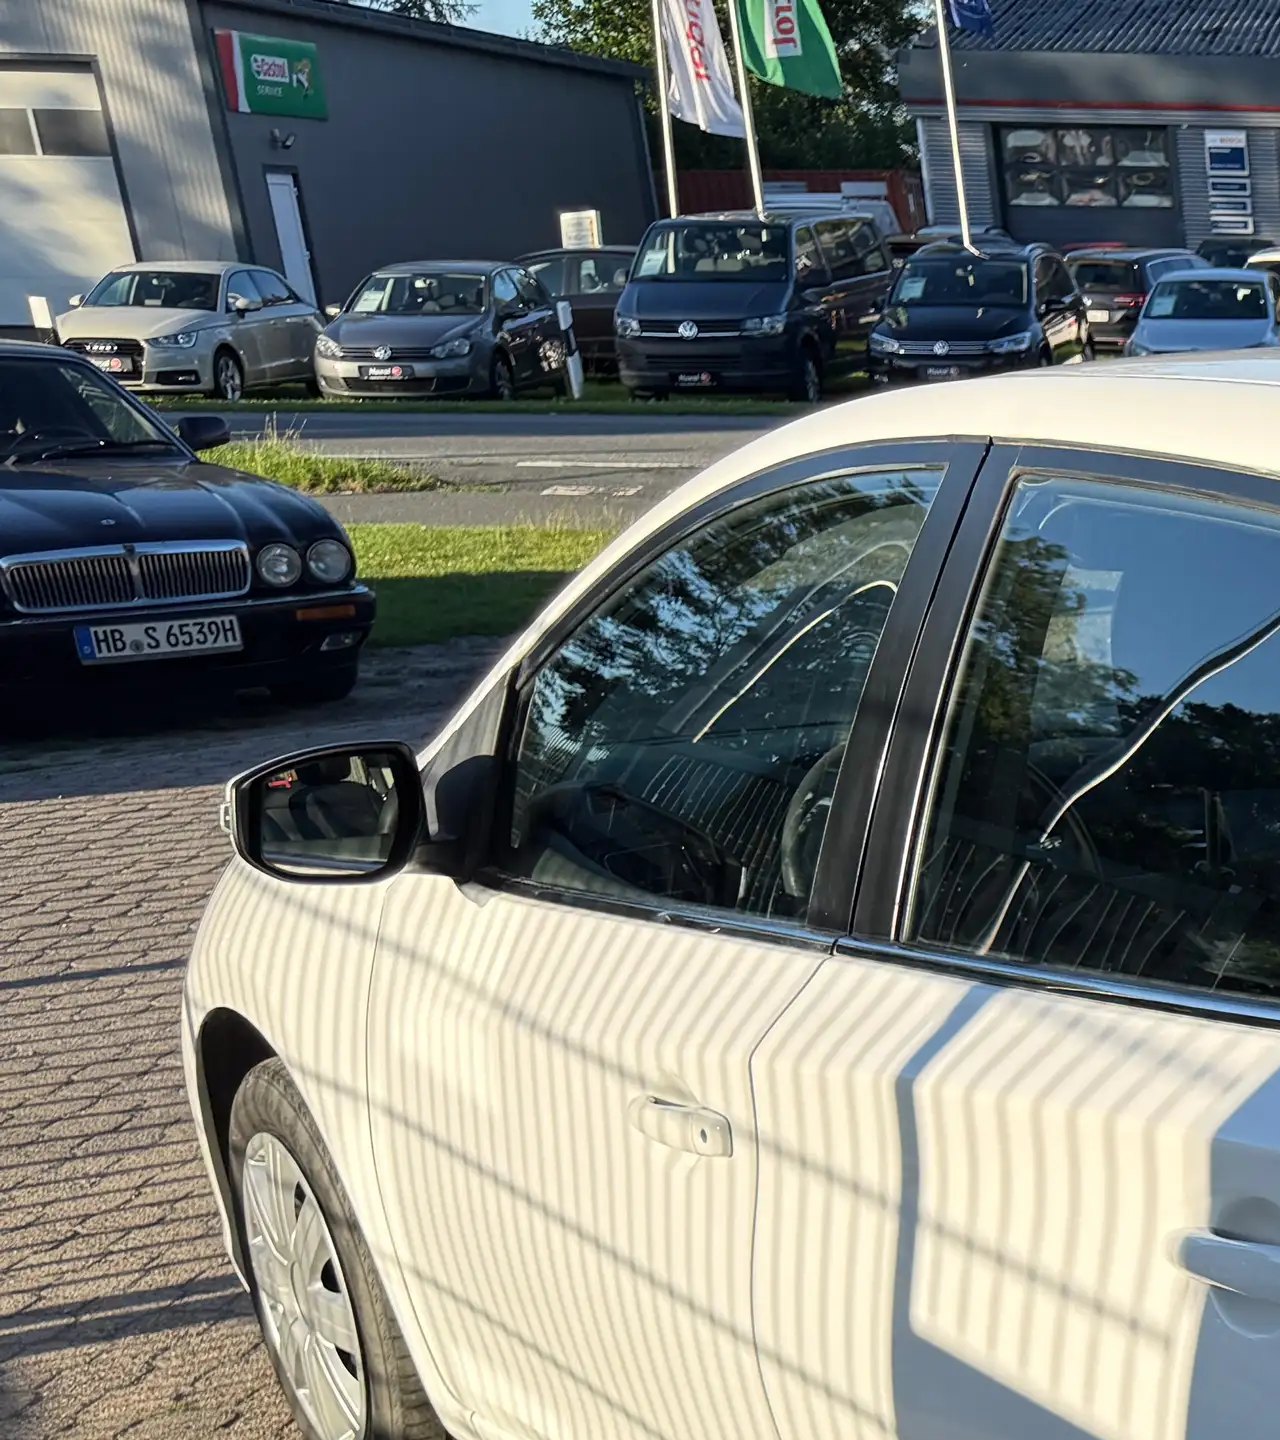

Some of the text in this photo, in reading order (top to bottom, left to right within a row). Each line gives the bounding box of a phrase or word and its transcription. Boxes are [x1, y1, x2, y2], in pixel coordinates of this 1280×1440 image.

[94, 619, 238, 654] HB S 6539H
